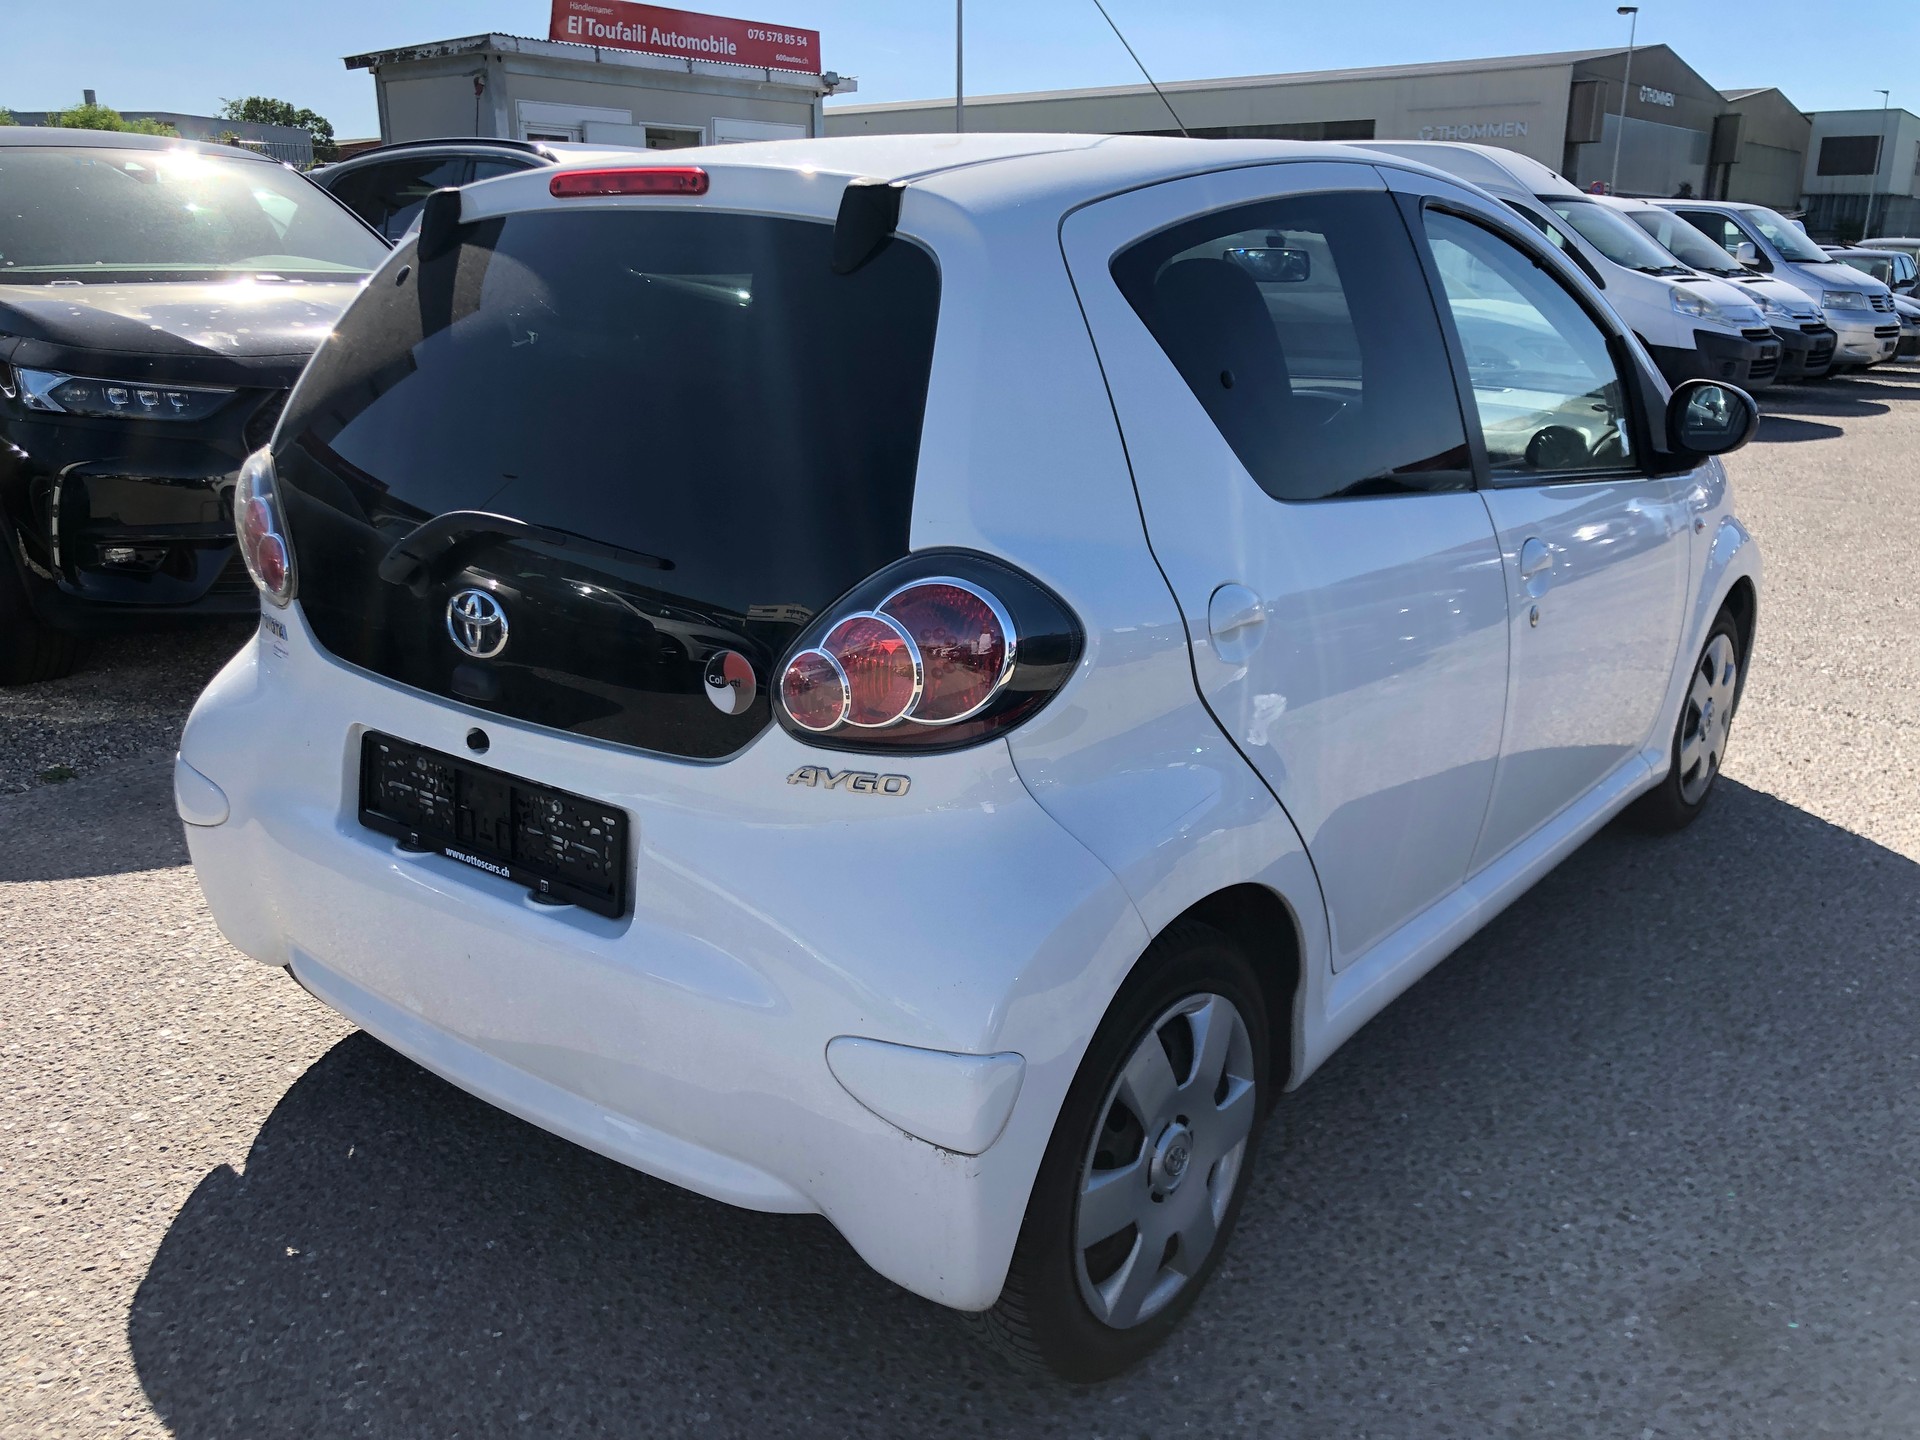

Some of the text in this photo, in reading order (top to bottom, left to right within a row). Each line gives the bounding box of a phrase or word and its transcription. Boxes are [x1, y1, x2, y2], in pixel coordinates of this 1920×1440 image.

[569, 2, 614, 15] Händlername:
[567, 15, 737, 56] El Toufaili Automobile
[747, 28, 808, 47] 076 578 85 54
[775, 53, 809, 65] 600autos.ch
[1437, 122, 1529, 140] THOMMEN
[786, 765, 912, 797] AYGO
[445, 847, 510, 878] www.ottoscars.ch
